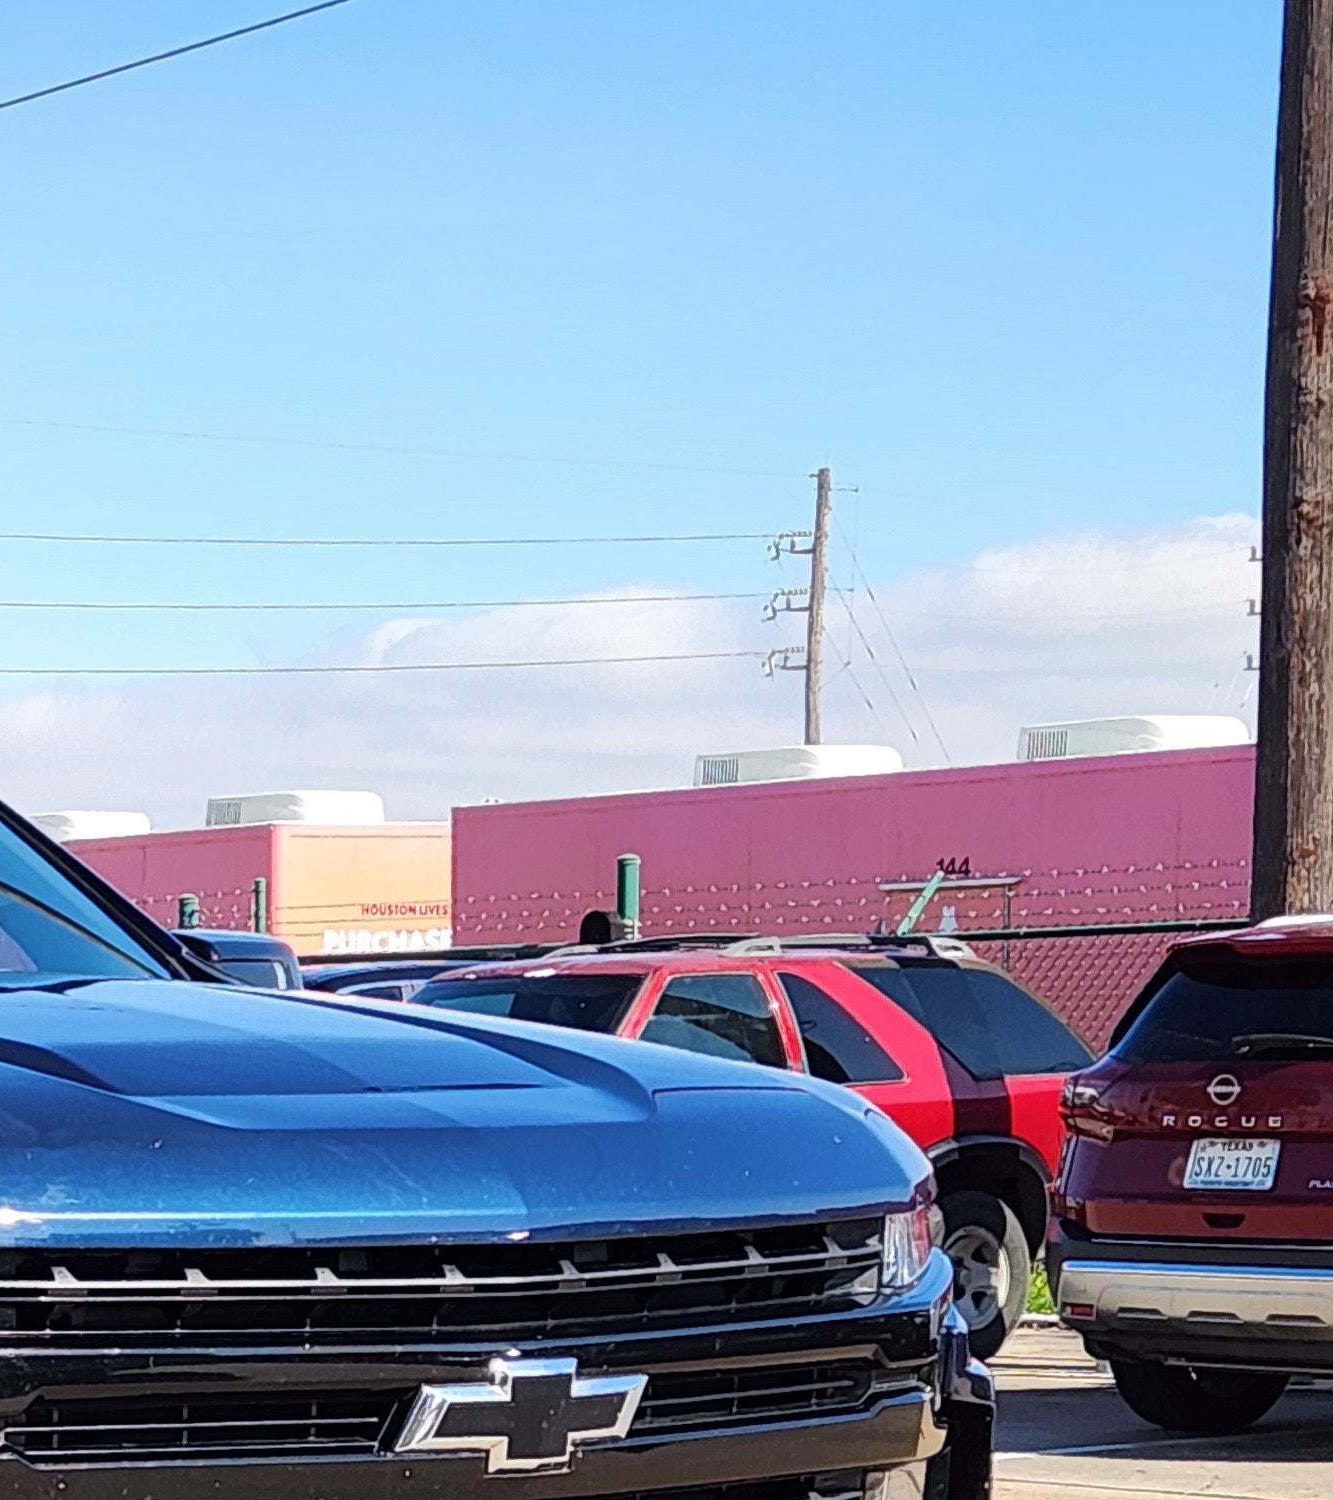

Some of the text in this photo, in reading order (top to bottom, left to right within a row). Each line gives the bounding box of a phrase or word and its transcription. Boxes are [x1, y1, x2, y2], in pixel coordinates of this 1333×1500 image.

[935, 856, 972, 876] 144
[361, 903, 448, 916] HOUSTON LIVES
[1162, 1115, 1282, 1128] ROGUE
[1221, 1139, 1254, 1152] TEXAS
[1308, 1179, 1333, 1189] PLA
